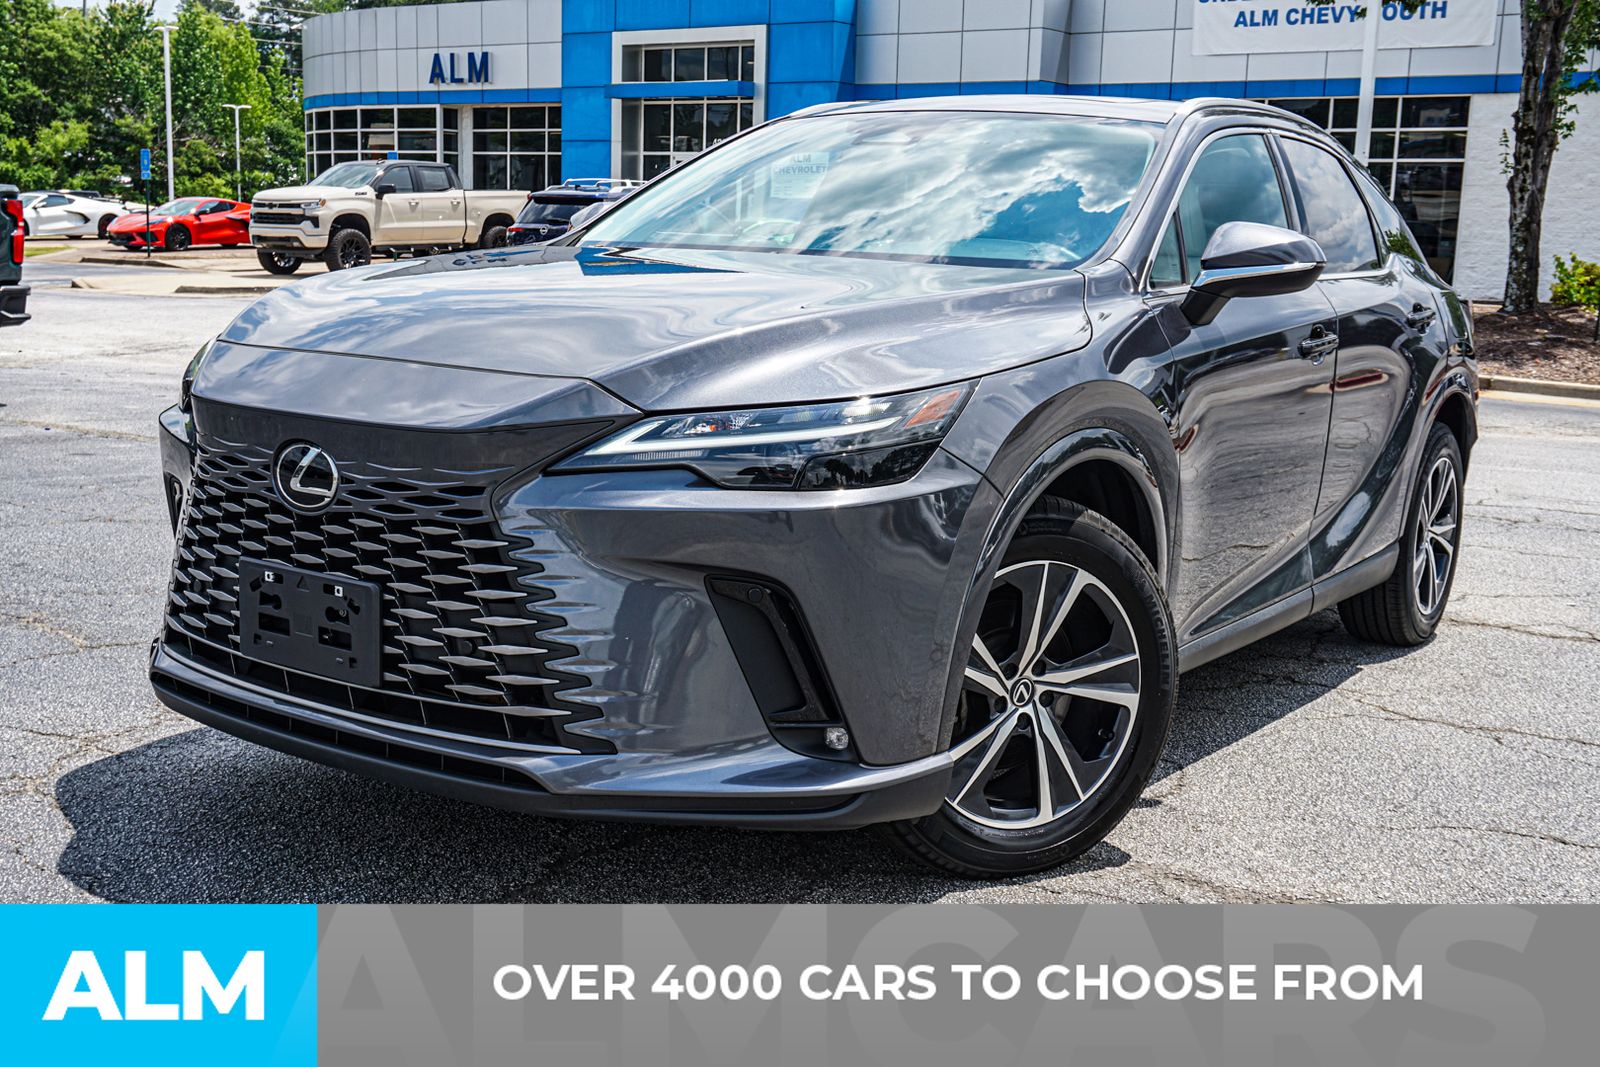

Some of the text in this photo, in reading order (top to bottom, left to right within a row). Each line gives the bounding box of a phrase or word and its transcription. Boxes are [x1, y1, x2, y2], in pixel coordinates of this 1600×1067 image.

[1234, 0, 1448, 28] ALM CHEVY OUTH
[428, 51, 489, 84] ALM
[1145, 592, 1171, 687] MICHELIN
